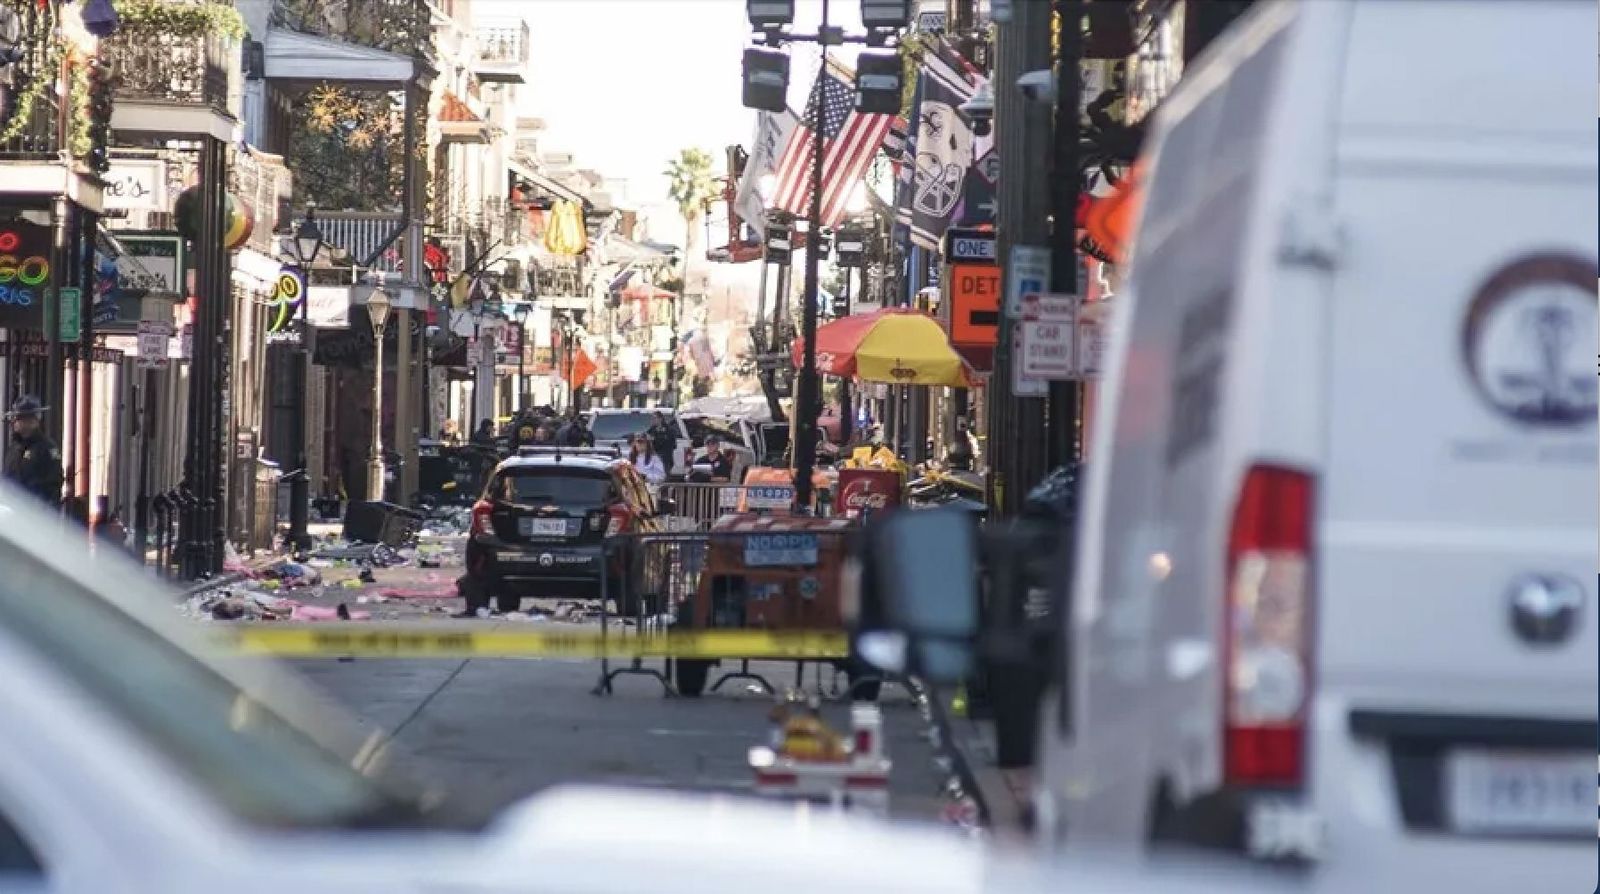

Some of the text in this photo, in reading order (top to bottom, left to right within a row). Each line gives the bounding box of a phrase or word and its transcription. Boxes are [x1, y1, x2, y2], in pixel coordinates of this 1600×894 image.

[956, 240, 987, 255] ONE
[1036, 326, 1060, 339] CAR
[1030, 343, 1067, 356] STAND
